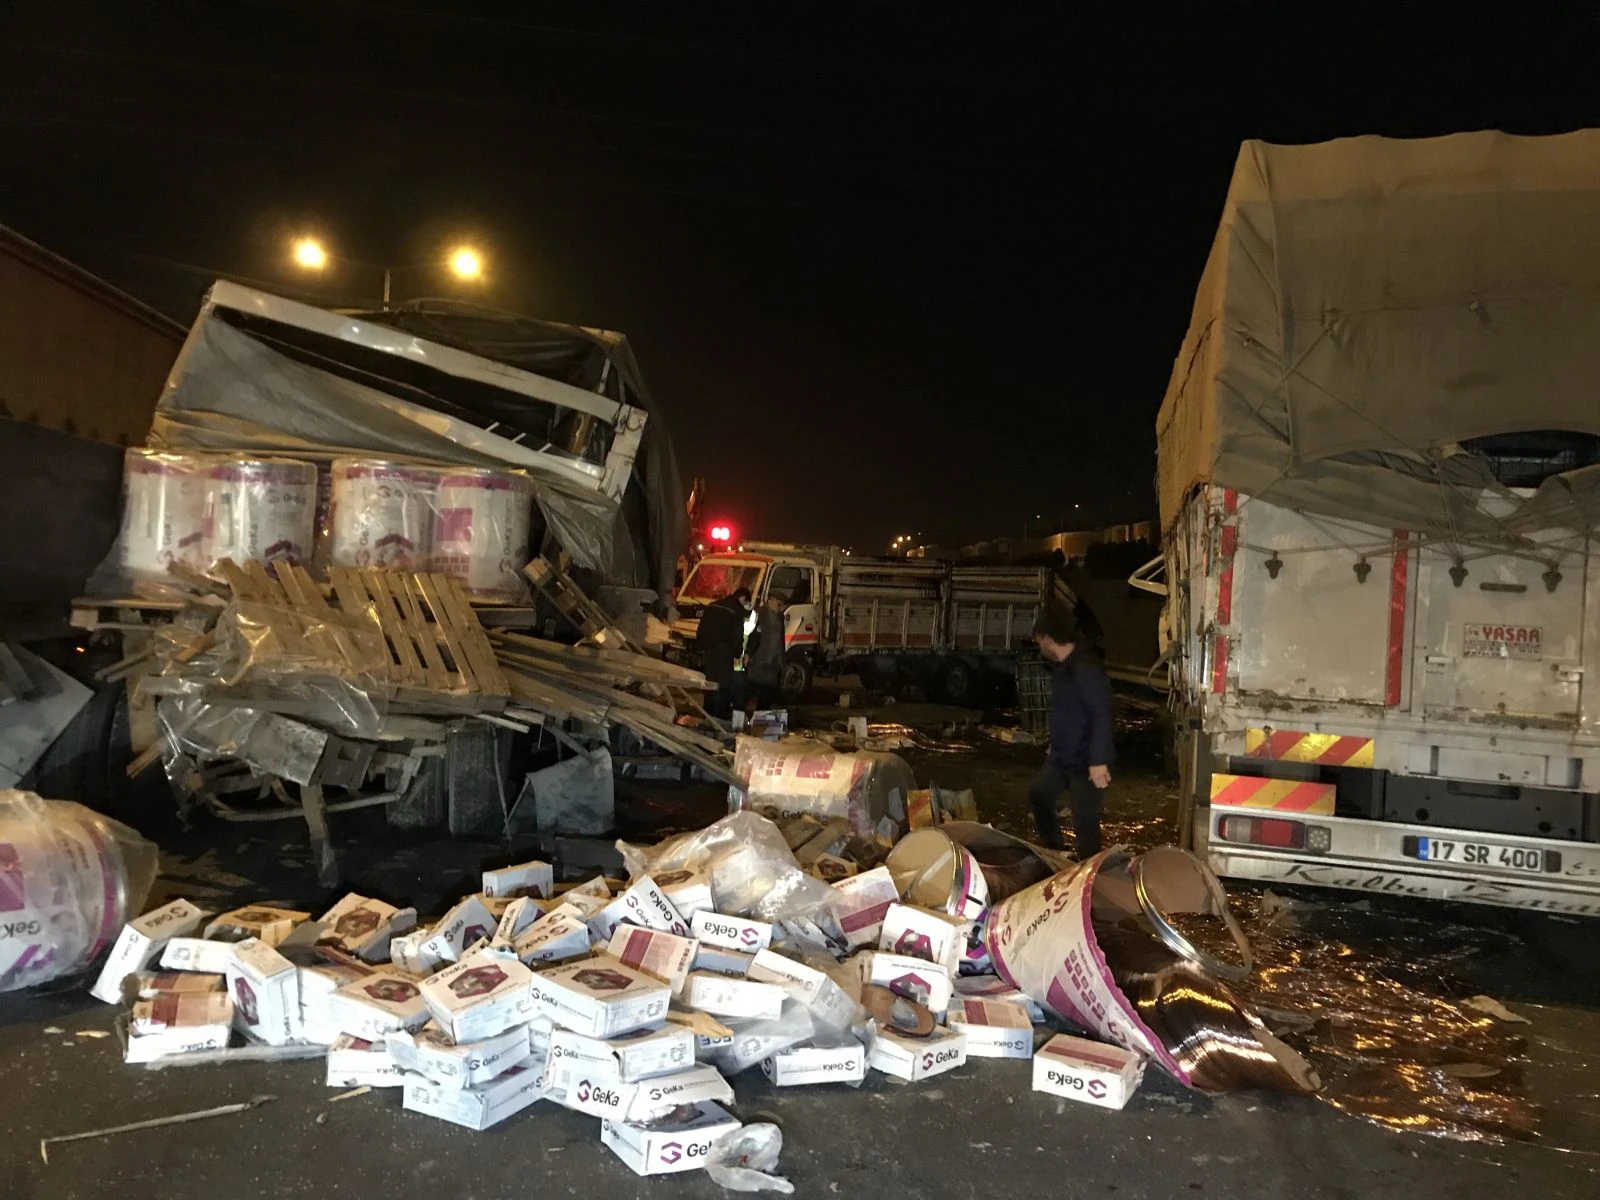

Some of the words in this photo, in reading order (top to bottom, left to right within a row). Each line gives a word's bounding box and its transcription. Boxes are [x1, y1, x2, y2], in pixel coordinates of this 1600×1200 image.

[1431, 840, 1455, 860] 17
[1463, 844, 1490, 864] SR
[1499, 848, 1539, 869] 400
[650, 890, 673, 921] GeKa
[0, 920, 41, 939] GeK
[704, 921, 738, 938] GeKa
[1026, 908, 1051, 937] GeKa
[541, 993, 559, 1006] GeKa
[993, 1040, 1013, 1048] GeKa
[482, 1054, 500, 1067] GeKa
[563, 1049, 579, 1059] GeKa
[935, 1047, 959, 1064] GeKa
[1047, 1070, 1084, 1090] GeKa
[592, 1086, 620, 1107] GeKa
[663, 1084, 684, 1096] GeKa
